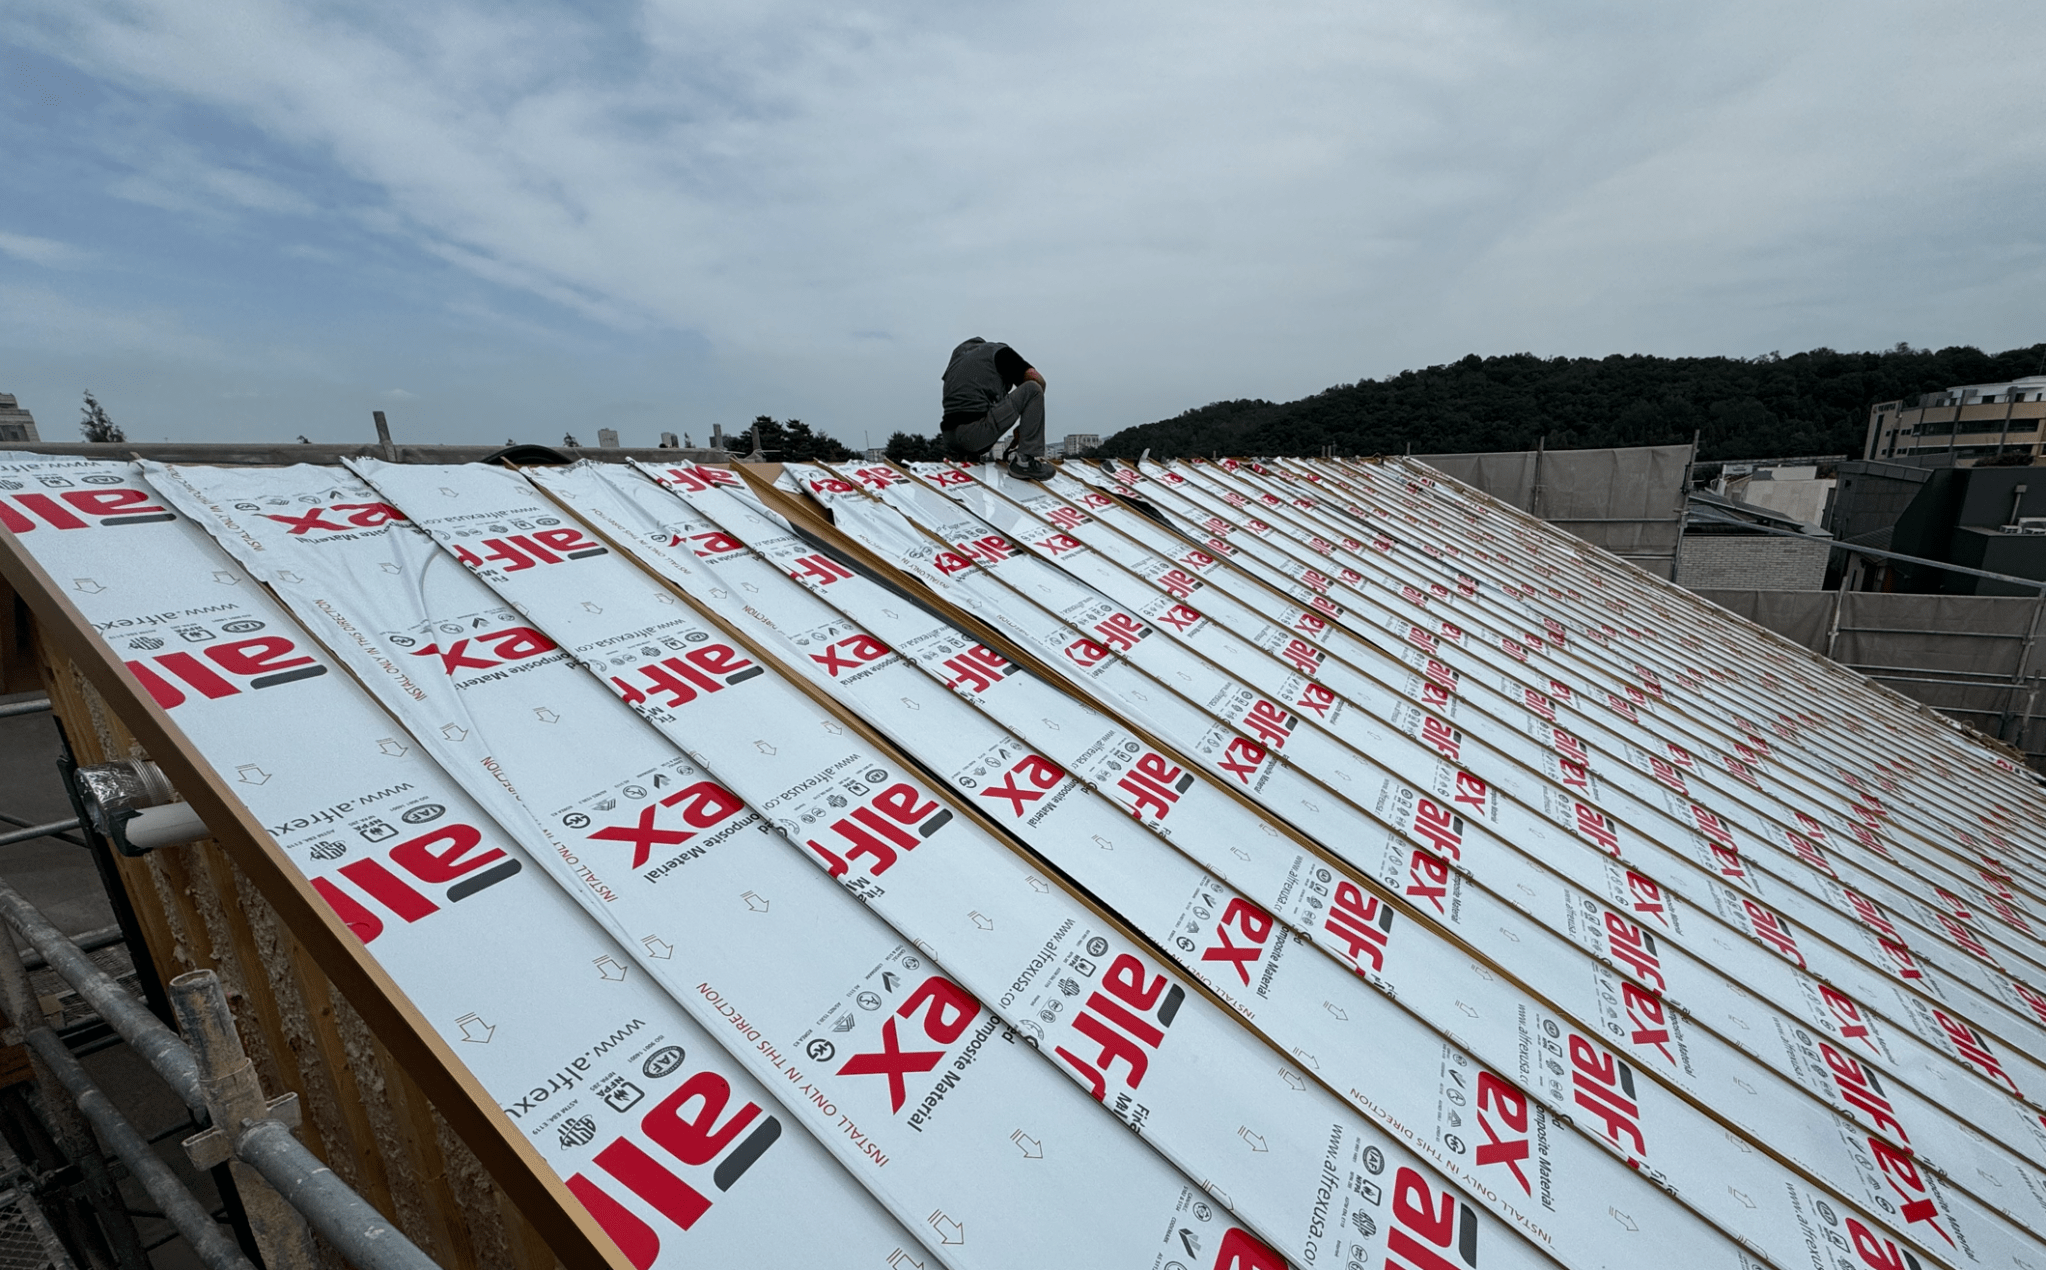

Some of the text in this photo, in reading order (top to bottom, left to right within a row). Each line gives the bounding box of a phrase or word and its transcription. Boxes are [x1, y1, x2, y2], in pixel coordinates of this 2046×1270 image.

[313, 599, 355, 632] DIRECTION
[1157, 604, 1201, 632] ex
[364, 647, 380, 655] IN
[372, 659, 399, 674] ONLY
[807, 634, 891, 678] ex
[394, 674, 427, 701] INSTALL
[1297, 683, 1334, 719] ex
[1216, 737, 1267, 785] ex
[979, 754, 1065, 818] ex
[1026, 778, 1079, 829] omposite Material
[1454, 770, 1487, 816] ex
[352, 817, 383, 832] NFPA
[643, 812, 760, 884] omposite Material
[552, 841, 579, 865] ONLY
[576, 865, 618, 902] INSTALL
[1406, 850, 1448, 915] ex
[1626, 871, 1669, 928] ex
[1200, 897, 1274, 988] ex
[1256, 925, 1289, 1000] omposite Material
[1215, 985, 1255, 1020] INSTALL
[1621, 981, 1677, 1068] ex
[834, 976, 982, 1116] ex
[596, 1076, 624, 1097] NFPA
[695, 982, 889, 1168] INSTALL ONLY IN THIS DIRECTION
[906, 1014, 1000, 1132] omposite Material
[1476, 1071, 1531, 1198] ex
[1535, 1104, 1555, 1213] omposite Material
[1349, 1087, 1552, 1244] INSTALL ONLY IN THIS DIRECTION
[1353, 1174, 1362, 1193] NFPA
